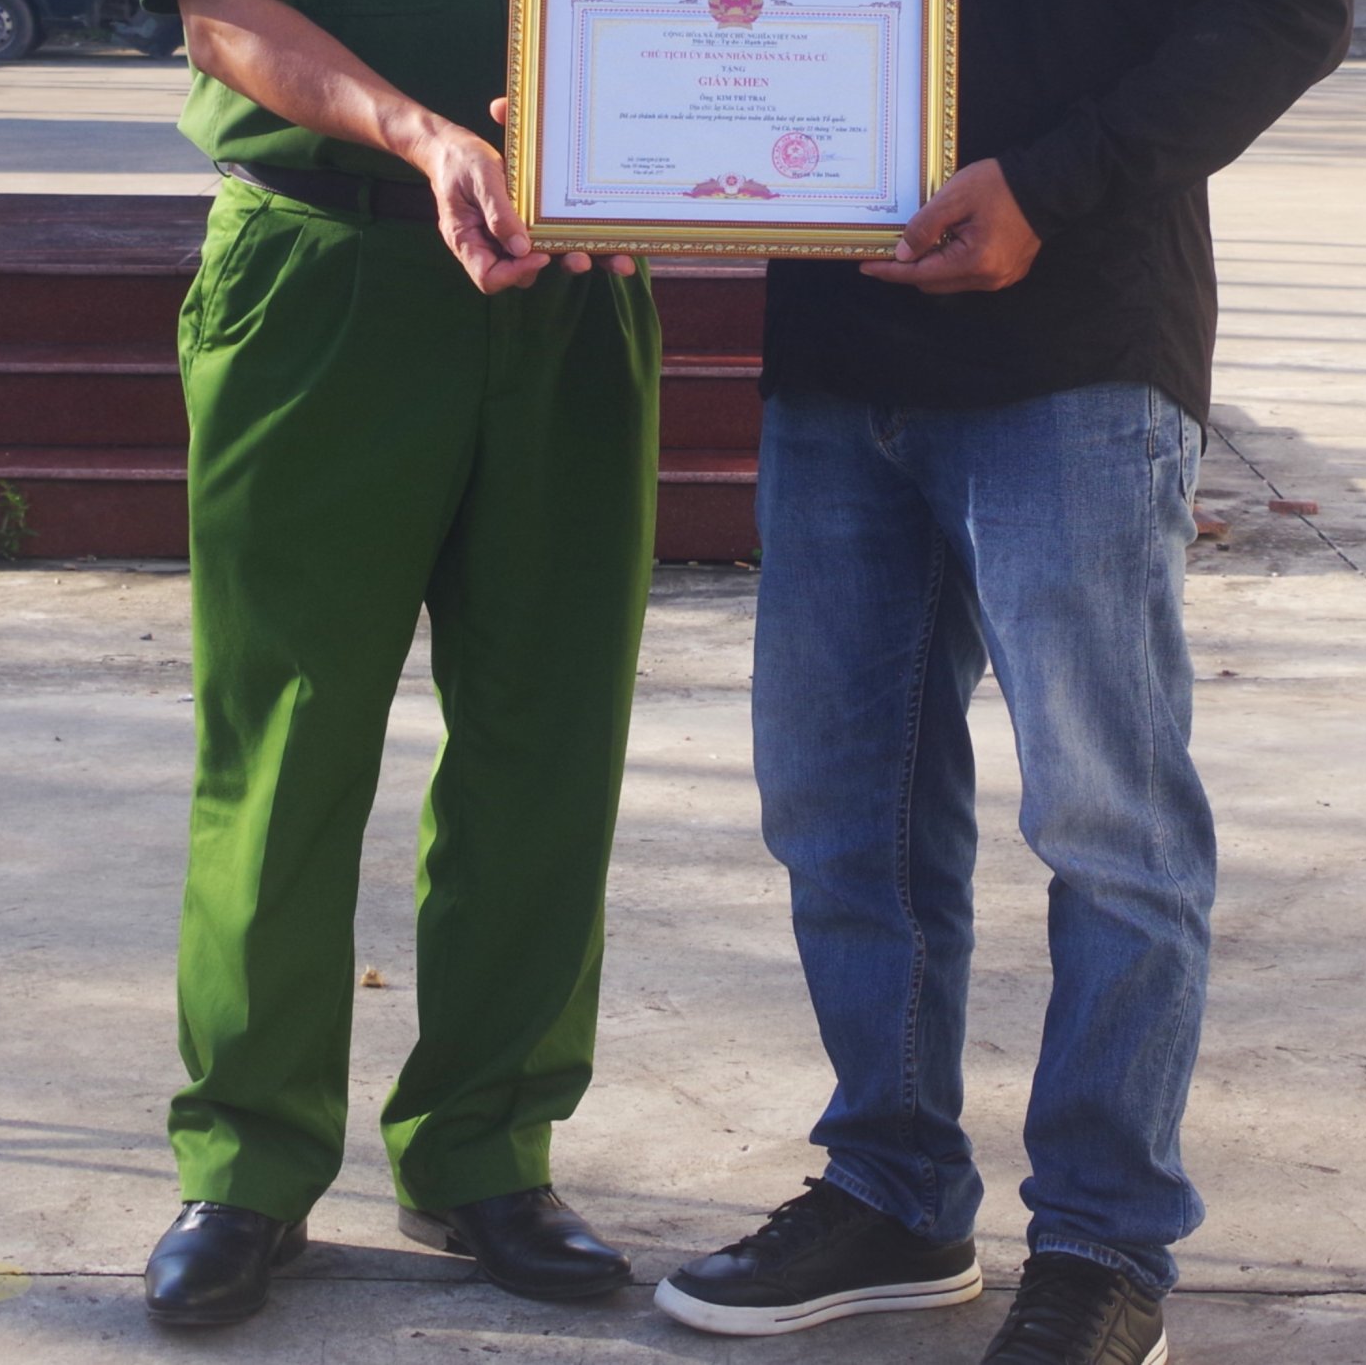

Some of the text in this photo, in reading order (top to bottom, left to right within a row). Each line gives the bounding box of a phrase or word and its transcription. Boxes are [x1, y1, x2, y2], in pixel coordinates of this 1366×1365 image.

[640, 50, 661, 59] CHỦ
[664, 50, 687, 60] TỊCH
[704, 52, 724, 60] BAN
[726, 51, 753, 61] NHÂN
[755, 52, 776, 61] DÂN
[777, 52, 791, 61] XÃ
[794, 52, 812, 61] TRÀ
[721, 65, 746, 74] TẶNG
[698, 74, 770, 87] GIẤY KHEN
[716, 94, 732, 102] KIM
